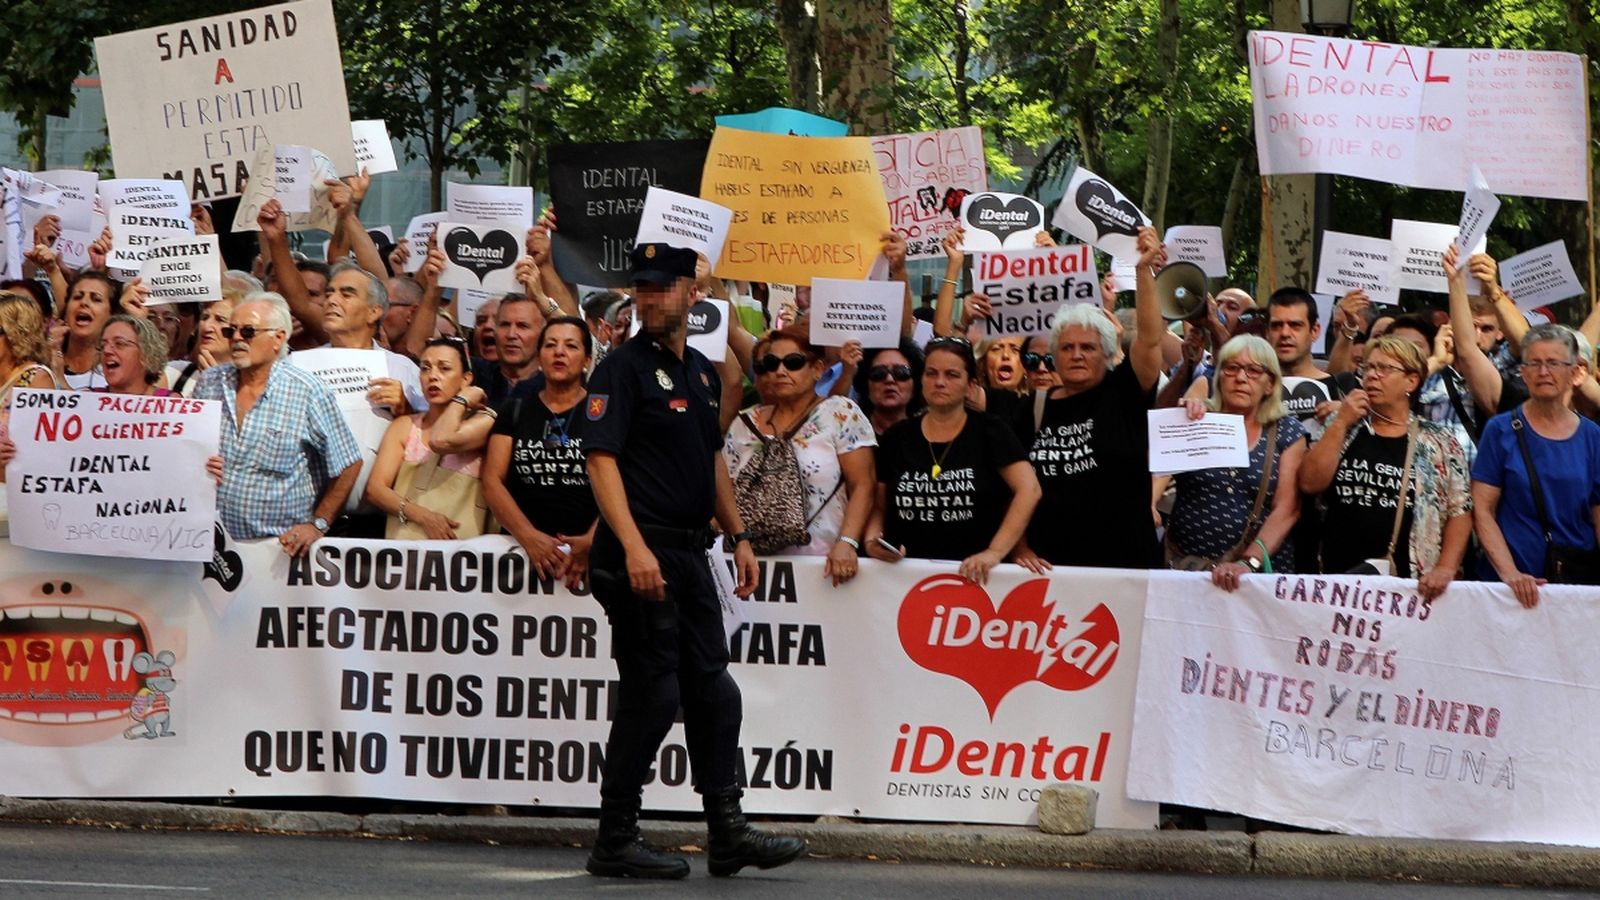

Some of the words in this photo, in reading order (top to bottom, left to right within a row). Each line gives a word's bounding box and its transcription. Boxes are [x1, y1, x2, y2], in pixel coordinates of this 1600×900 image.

[156, 9, 298, 62] SANIDAD
[1252, 34, 1450, 83] IDENTAL
[214, 58, 234, 86] A
[163, 82, 303, 129] PERMITIDO
[1268, 112, 1338, 133] DANOS
[1355, 113, 1454, 132] NUESTRO
[203, 125, 271, 159] ESTA
[1299, 137, 1402, 160] DINERO
[781, 160, 802, 175] SIN
[760, 183, 814, 198] ESTAFADO
[829, 186, 843, 198] A
[762, 211, 776, 224] DE
[787, 209, 849, 225] PERSONAS
[980, 208, 1029, 221] iDental
[1087, 194, 1136, 226] iDental
[663, 225, 709, 243] NACIONAL
[457, 243, 505, 260] iDental
[160, 261, 191, 272] EXIGE
[980, 245, 1088, 281] iDental
[151, 273, 202, 286] NUESTROS
[148, 286, 209, 298] HISTORIALES
[983, 276, 1094, 308] Estafa
[826, 312, 878, 321] ESTAFADOS
[823, 322, 881, 331] INFECTADOS
[16, 392, 80, 409] SOMOS
[35, 412, 82, 441] NO
[527, 439, 544, 449] LA
[70, 455, 151, 474] IDENTAL
[516, 463, 589, 475] IDENTA
[1042, 464, 1058, 476] LE
[1064, 456, 1098, 475] GANA
[1352, 458, 1369, 470] LA
[21, 475, 103, 495] ESTAFA
[540, 475, 555, 486] LE
[901, 471, 910, 480] A
[914, 471, 929, 481] LA
[897, 480, 976, 494] SEVILLANA
[895, 495, 974, 508] IDENTAL
[1358, 495, 1373, 507] LE
[899, 509, 915, 521] NO
[920, 509, 935, 522] LE
[941, 509, 973, 522] GANA
[256, 607, 499, 656] AFECTADOS
[511, 614, 597, 659] POR
[1332, 612, 1383, 643] NOS
[927, 603, 1120, 678] iDental
[1295, 636, 1397, 681] ROBAS
[341, 669, 392, 713] DE
[405, 672, 483, 717] LOS
[1324, 684, 1352, 719] Y
[1356, 691, 1386, 723] EL
[244, 730, 324, 777] QUE
[332, 730, 387, 774] NO
[400, 735, 604, 784] TUVIERON
[889, 722, 1112, 783] iDental
[1264, 719, 1516, 791] BARCELONA
[886, 781, 971, 799] DENTISTAS
[981, 787, 1009, 801] SIN
